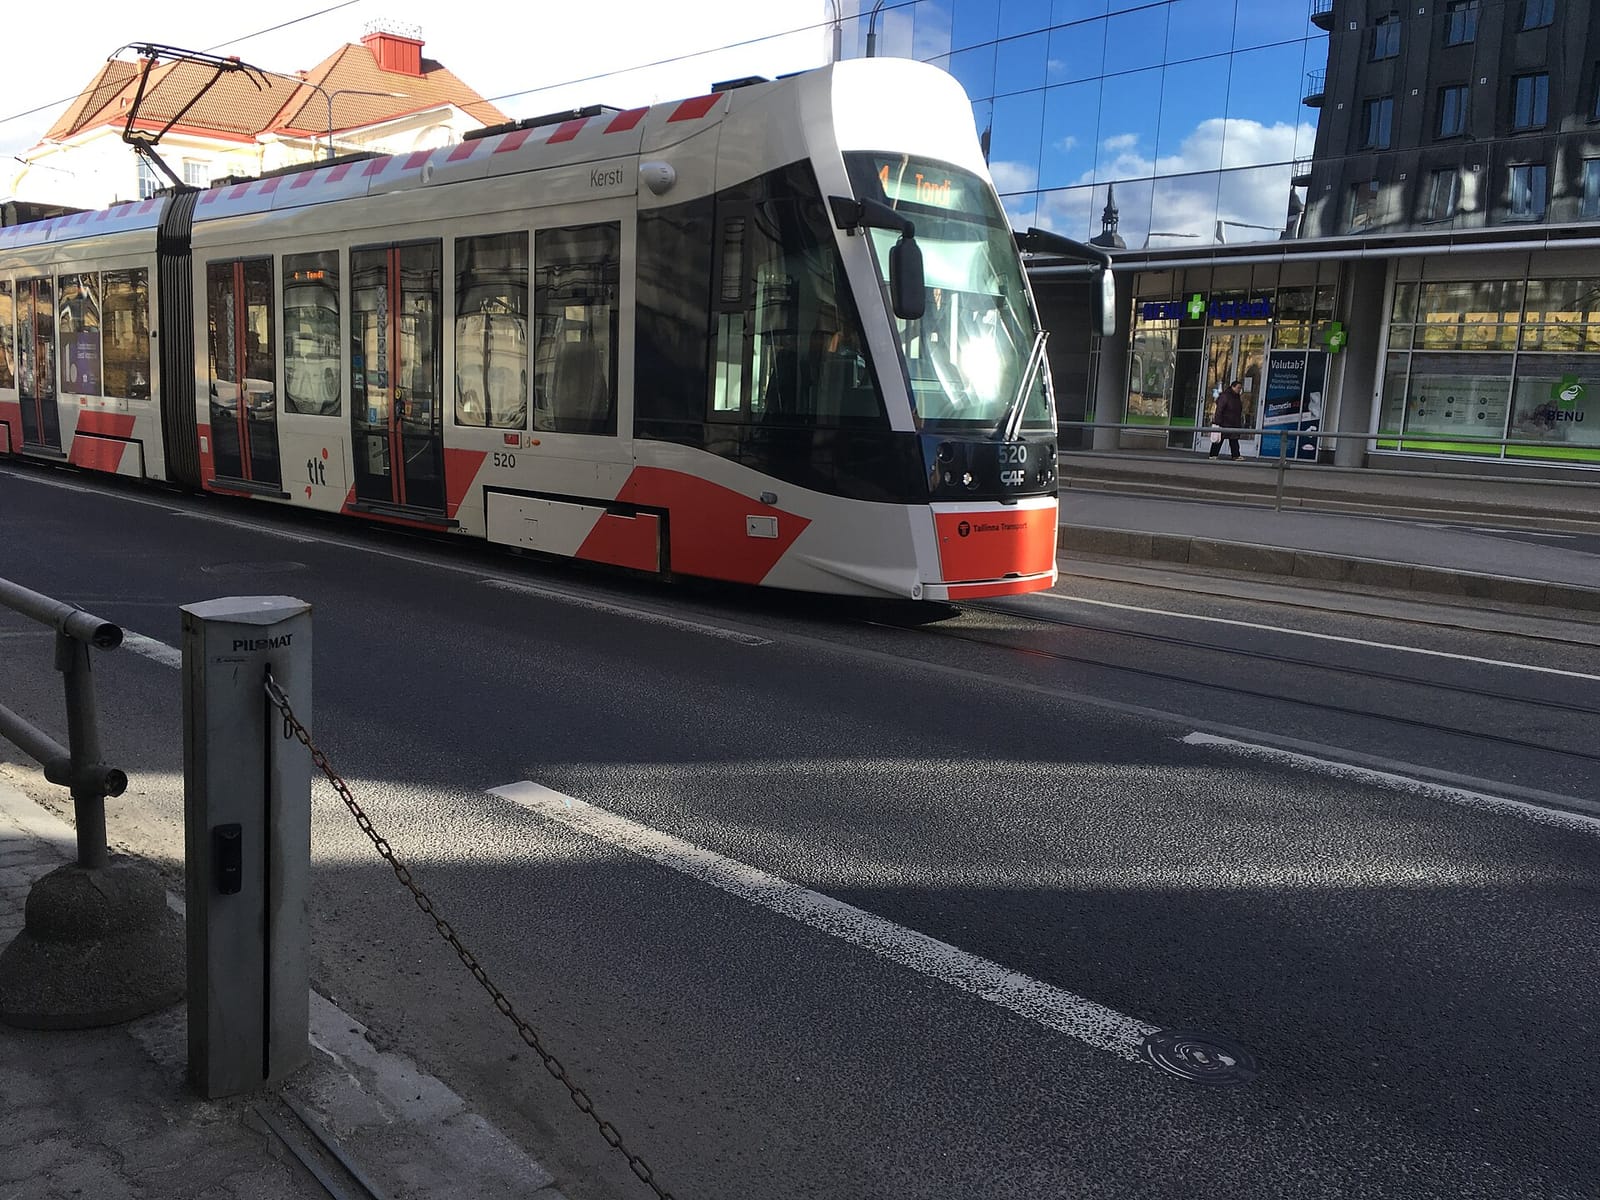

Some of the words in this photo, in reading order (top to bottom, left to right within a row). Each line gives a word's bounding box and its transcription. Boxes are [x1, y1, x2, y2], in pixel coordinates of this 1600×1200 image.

[590, 165, 624, 188] Kersti
[915, 173, 951, 206] Tondi
[306, 270, 325, 280] Tondi
[1143, 301, 1187, 320] BENU
[1209, 295, 1272, 321] Apteek
[1271, 359, 1305, 370] Valutab?
[1547, 408, 1585, 423] BENU
[493, 452, 516, 469] 520
[999, 445, 1028, 464] 520
[973, 523, 1000, 533] Tallinna
